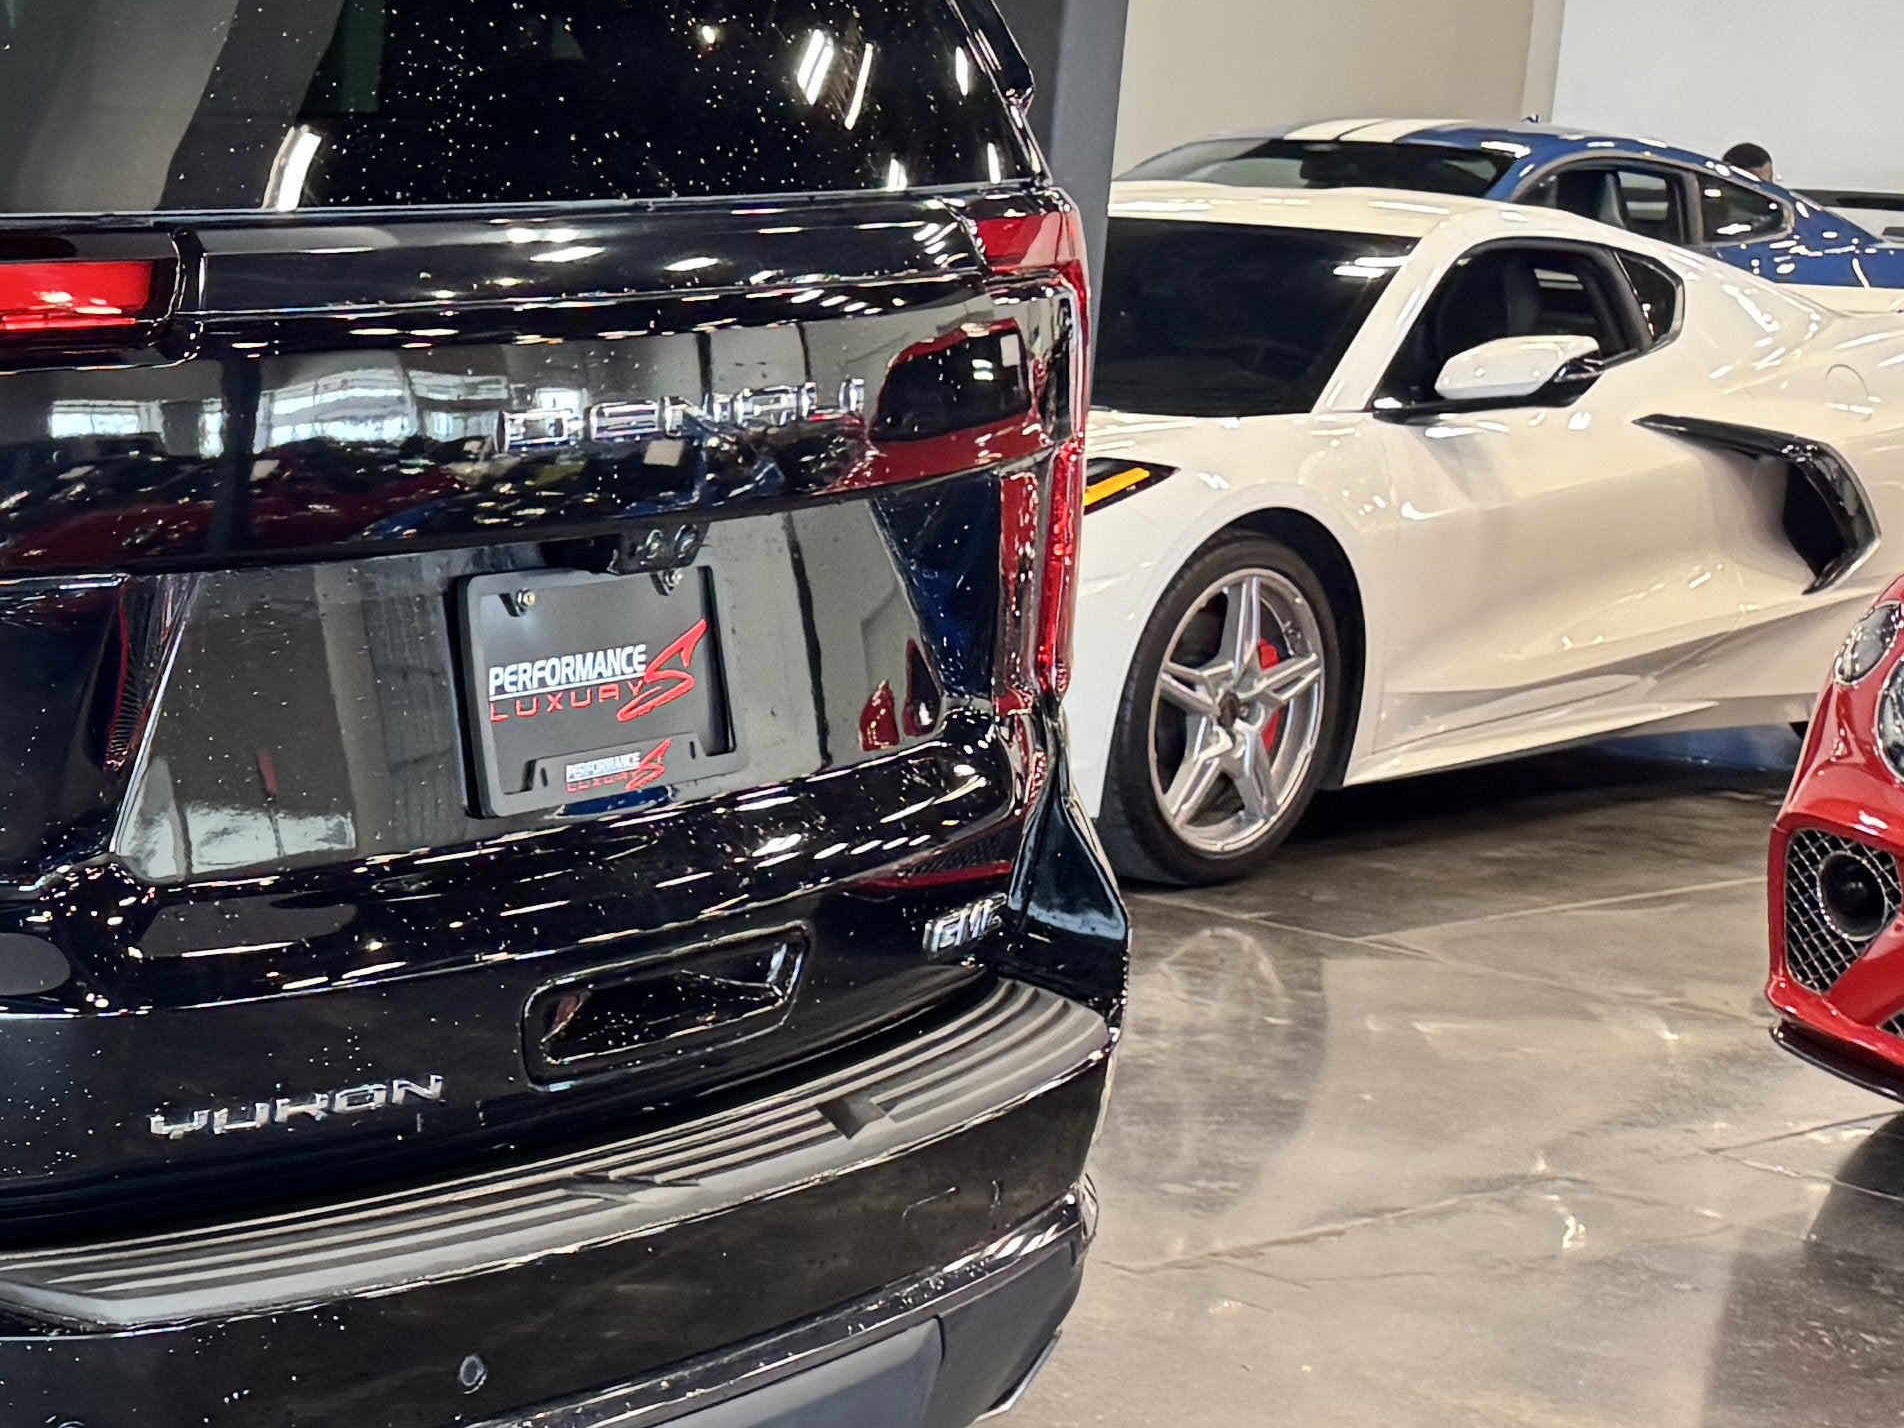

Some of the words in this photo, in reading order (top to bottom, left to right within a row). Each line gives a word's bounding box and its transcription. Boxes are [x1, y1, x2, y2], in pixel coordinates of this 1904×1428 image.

[489, 644, 647, 697] PERFORMANCE
[490, 679, 644, 723] LUXURY
[922, 893, 1008, 953] GMC
[149, 1074, 444, 1140] YUKON
